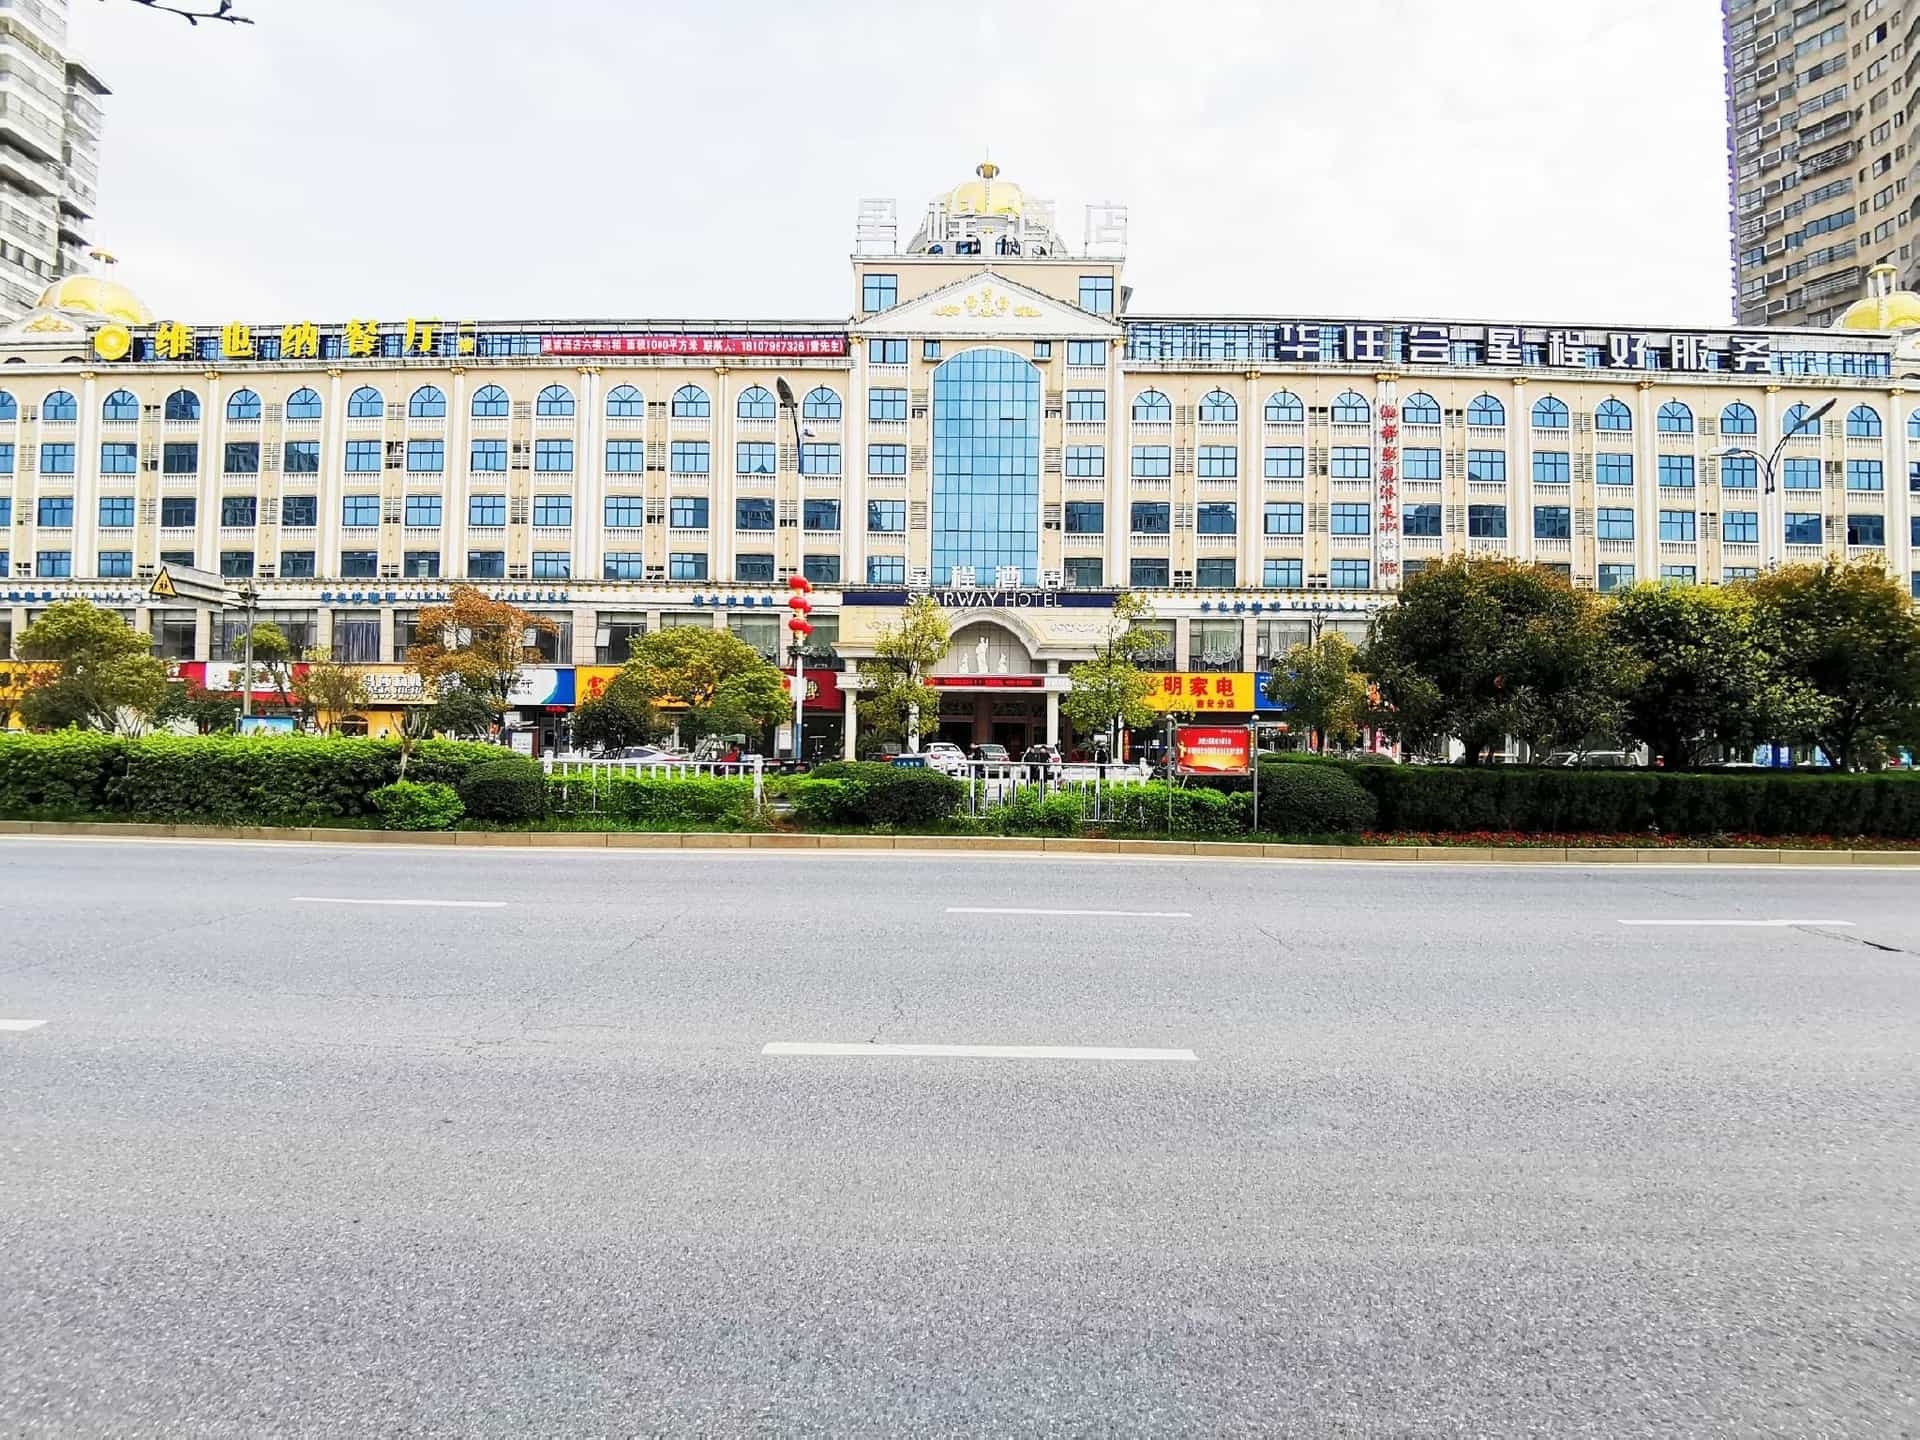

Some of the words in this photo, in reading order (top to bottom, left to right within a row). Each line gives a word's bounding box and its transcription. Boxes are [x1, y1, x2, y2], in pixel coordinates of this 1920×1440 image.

[156, 316, 440, 358] 维也纳餐厅
[907, 565, 1063, 591] 星程酒店
[907, 592, 998, 606] STARWAY
[1004, 592, 1062, 607] HOTEL
